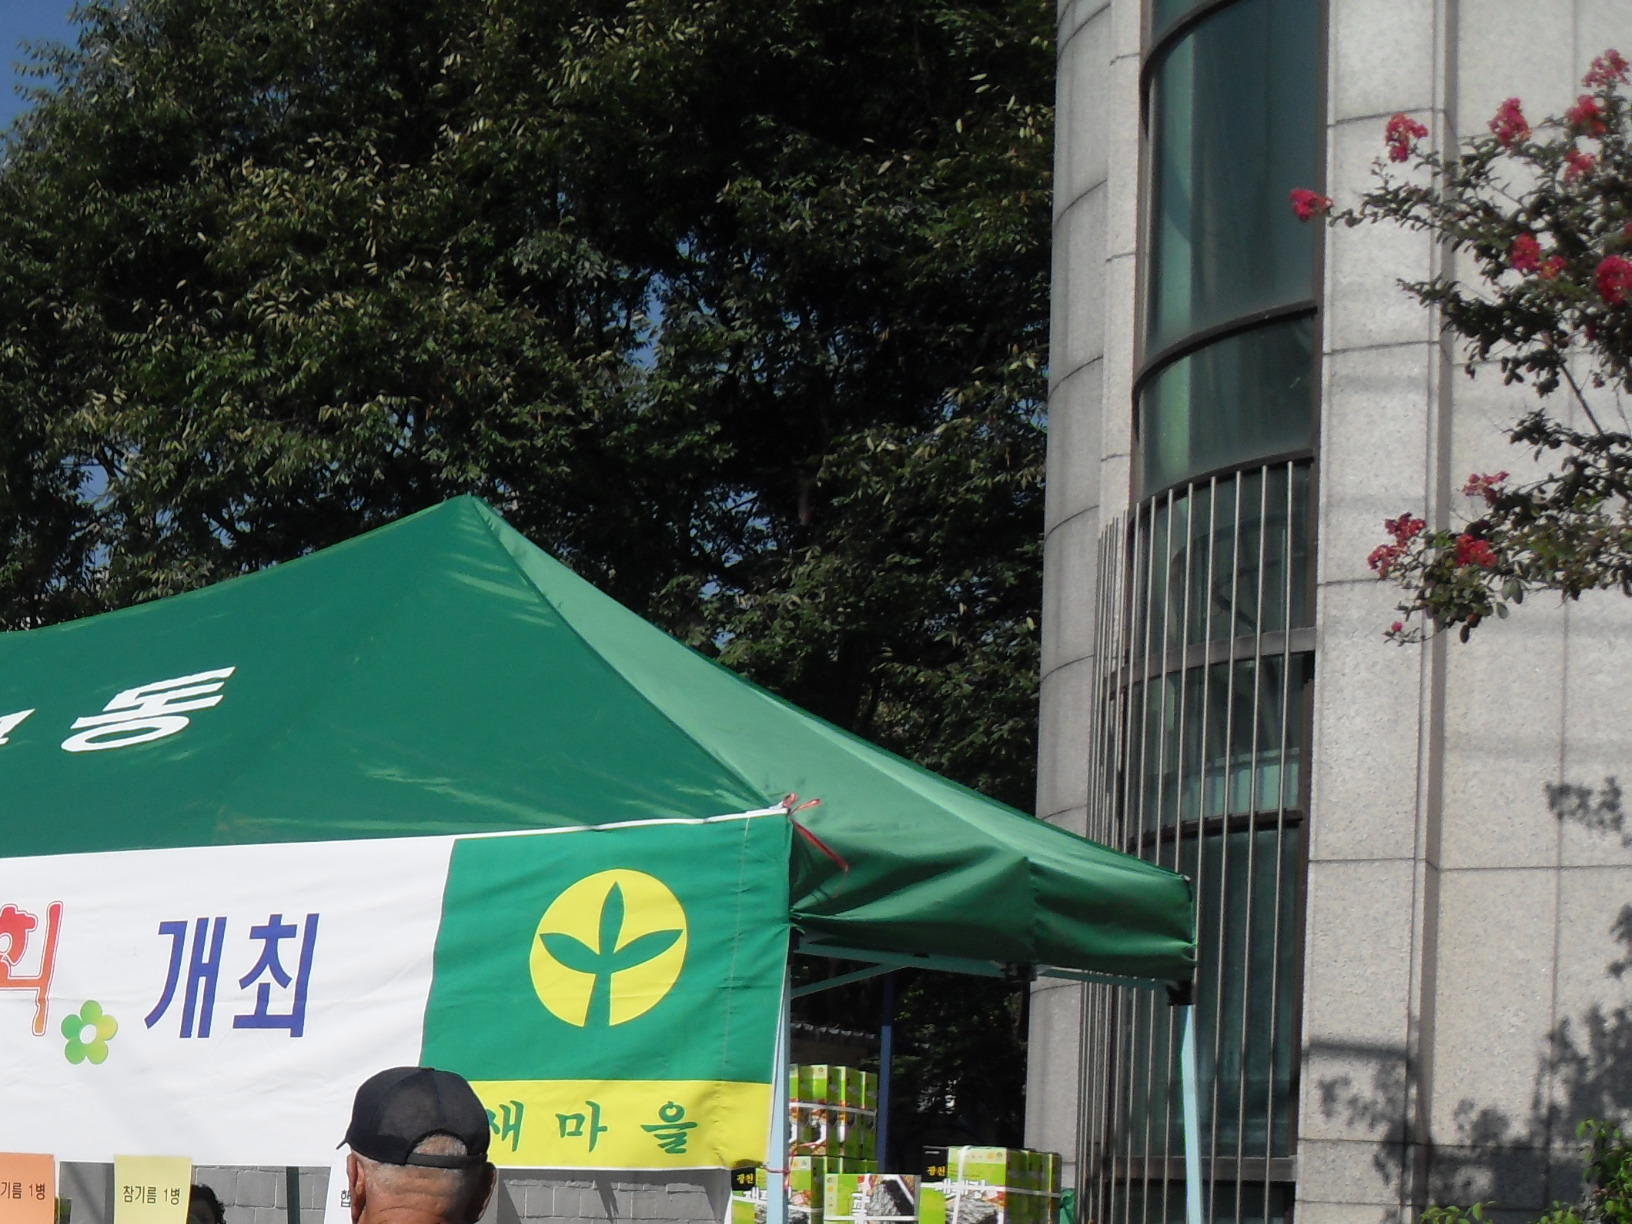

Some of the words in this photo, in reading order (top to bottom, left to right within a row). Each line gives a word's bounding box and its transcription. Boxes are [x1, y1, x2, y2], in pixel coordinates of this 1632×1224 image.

[144, 913, 319, 1039] 개최
[28, 1182, 47, 1201] 1병
[123, 1184, 157, 1204] 참기름
[163, 1187, 181, 1206] 1병
